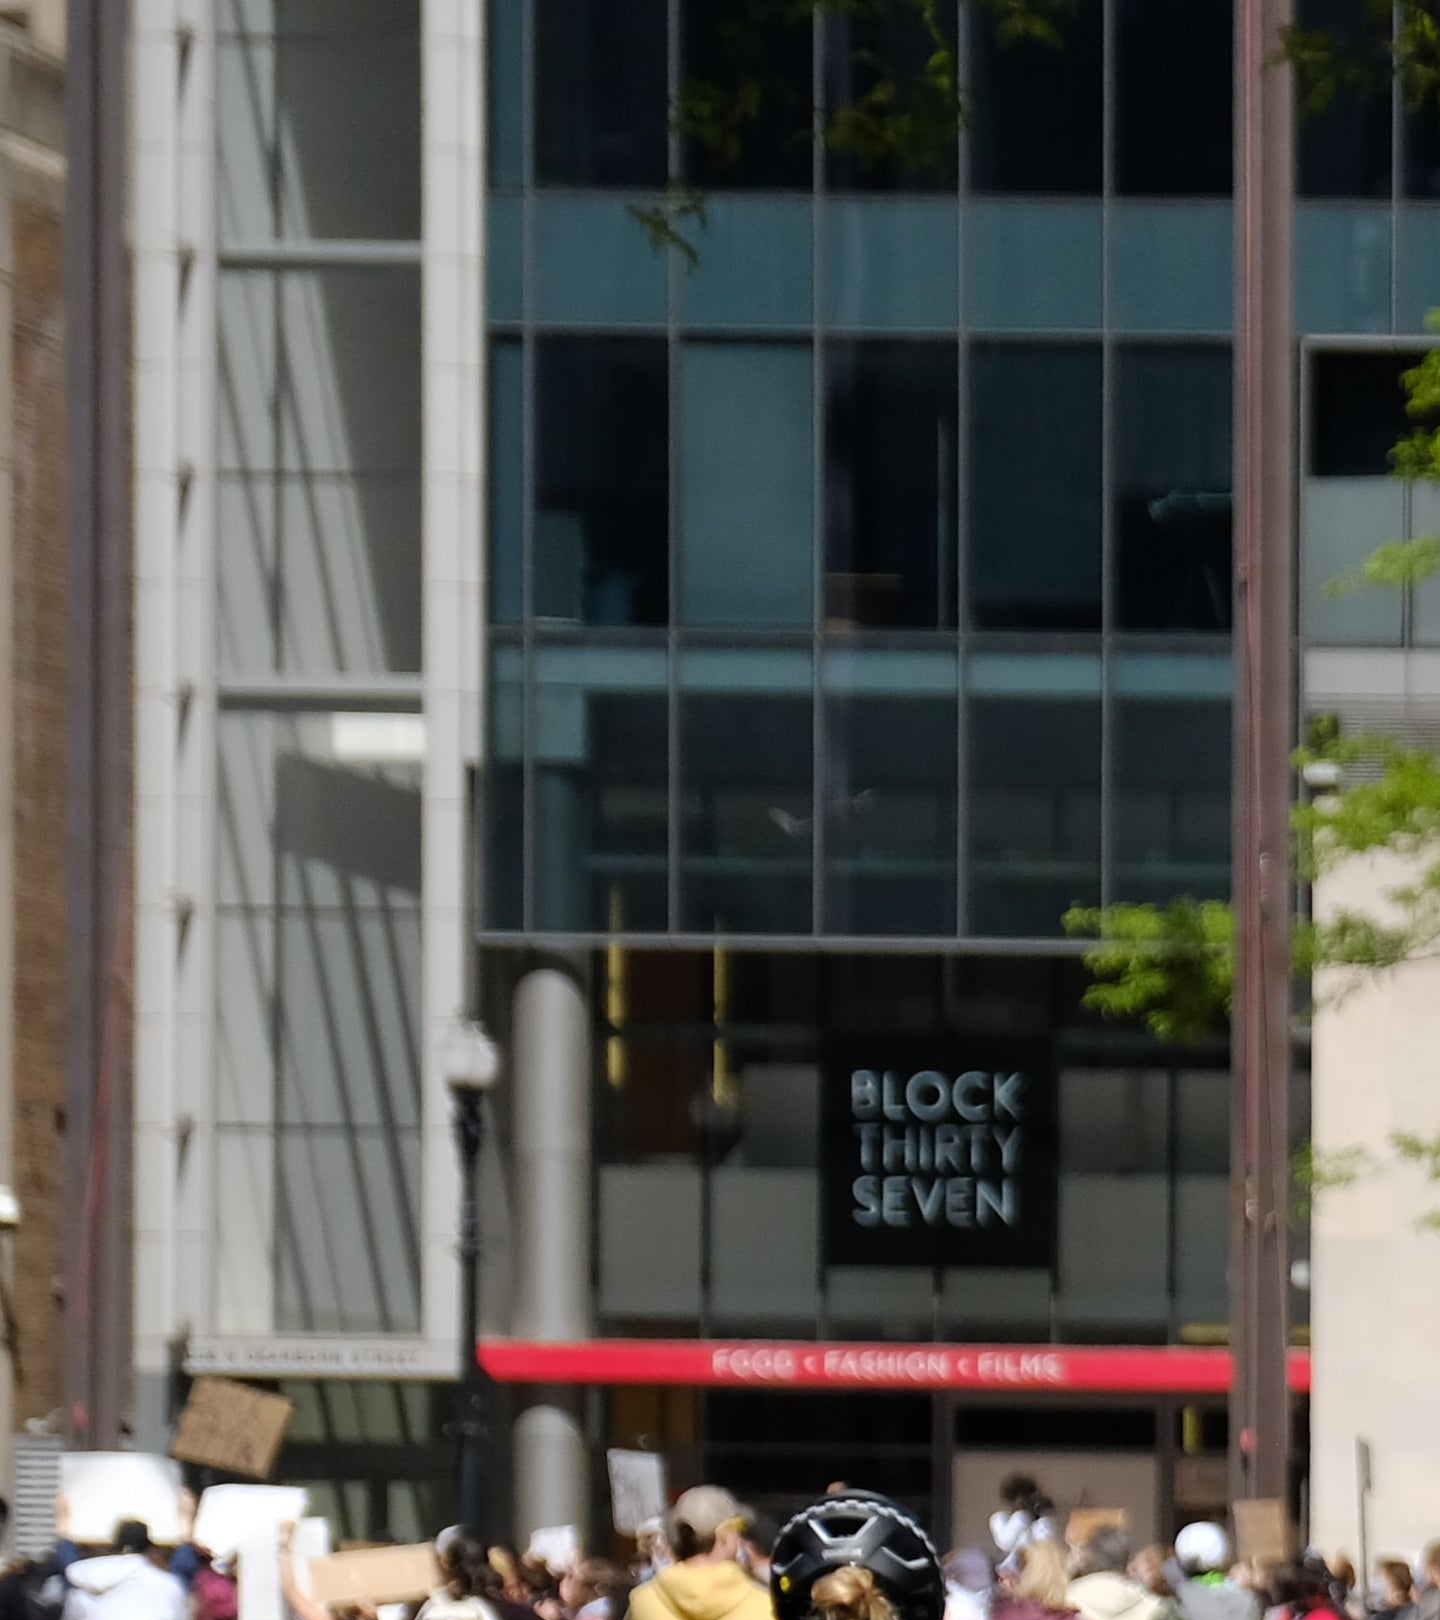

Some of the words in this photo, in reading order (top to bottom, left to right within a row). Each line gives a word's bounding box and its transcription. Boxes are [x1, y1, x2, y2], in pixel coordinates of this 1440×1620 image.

[851, 1069, 1020, 1122] BLOCK
[853, 1123, 1021, 1173] THIRTY
[852, 1174, 1018, 1227] SEVEN
[712, 1348, 797, 1379] FOOD
[824, 1349, 951, 1382] FASHION
[977, 1351, 1064, 1383] FILMS
